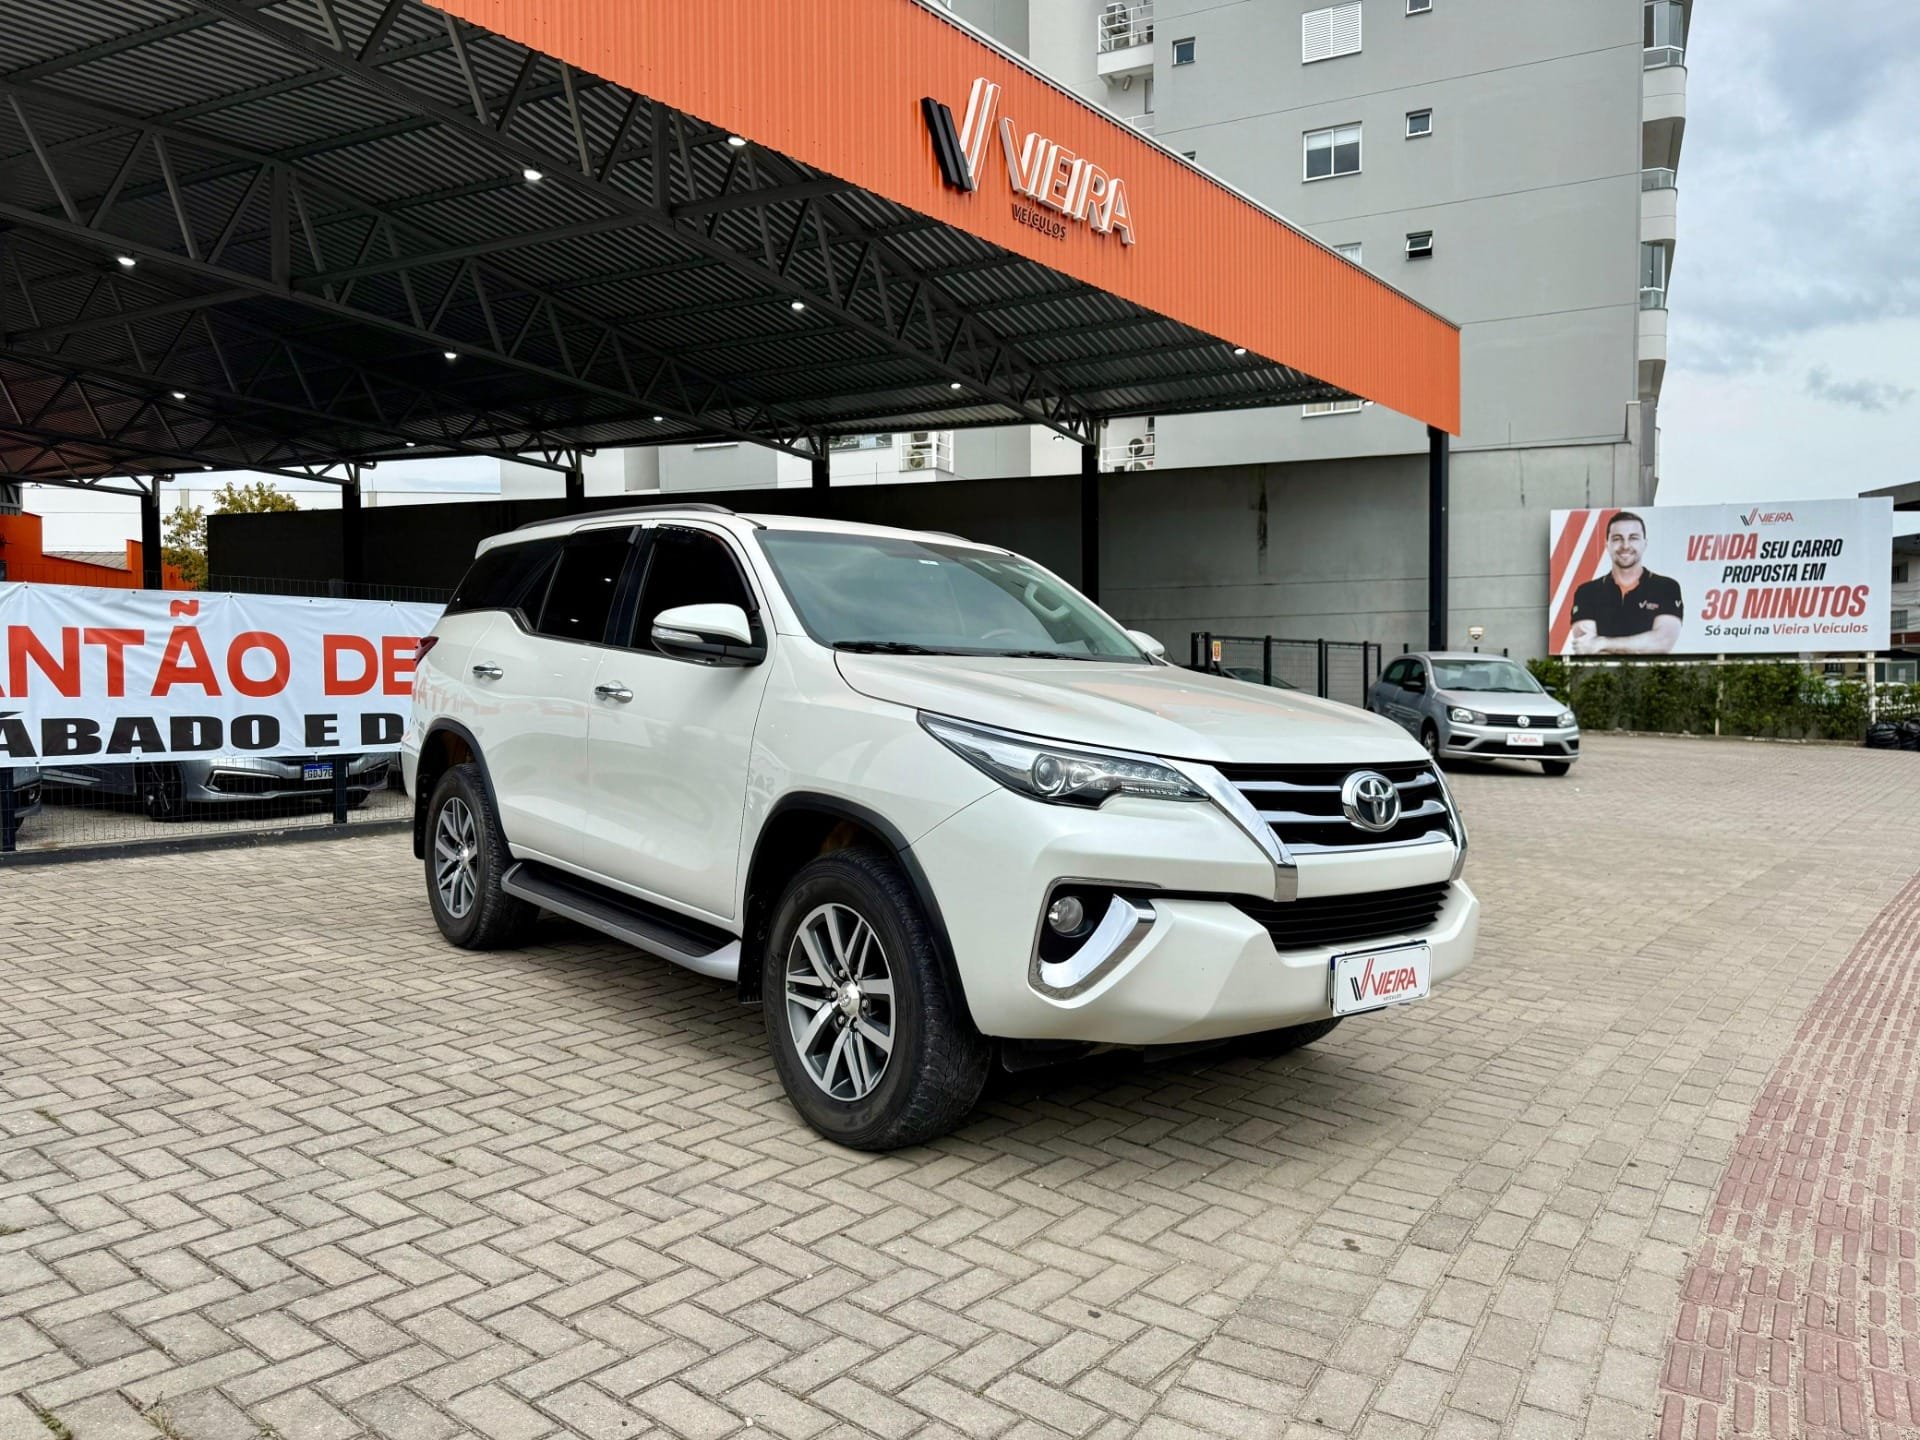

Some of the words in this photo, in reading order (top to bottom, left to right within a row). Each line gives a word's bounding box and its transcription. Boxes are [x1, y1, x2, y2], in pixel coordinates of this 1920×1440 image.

[1000, 116, 1136, 245] VIEIRA
[1013, 202, 1067, 239] VEÍCULOS
[1758, 511, 1794, 523] VIEIRA
[1686, 532, 1759, 562] VENDA
[1759, 540, 1790, 559] SEU
[1791, 538, 1844, 559] CARRO
[1721, 564, 1798, 583] PROPOSTA
[1801, 563, 1827, 581] EM
[1701, 588, 1738, 620] 30
[1741, 584, 1870, 619] MINUTOS
[1704, 624, 1721, 636] Só
[1723, 624, 1751, 638] aqui
[1753, 626, 1770, 635] na
[1772, 623, 1810, 635] Vieira
[0, 600, 290, 698] NTÃO
[323, 634, 420, 696] DE
[304, 714, 340, 747] E
[1371, 966, 1418, 996] VIEIRA
